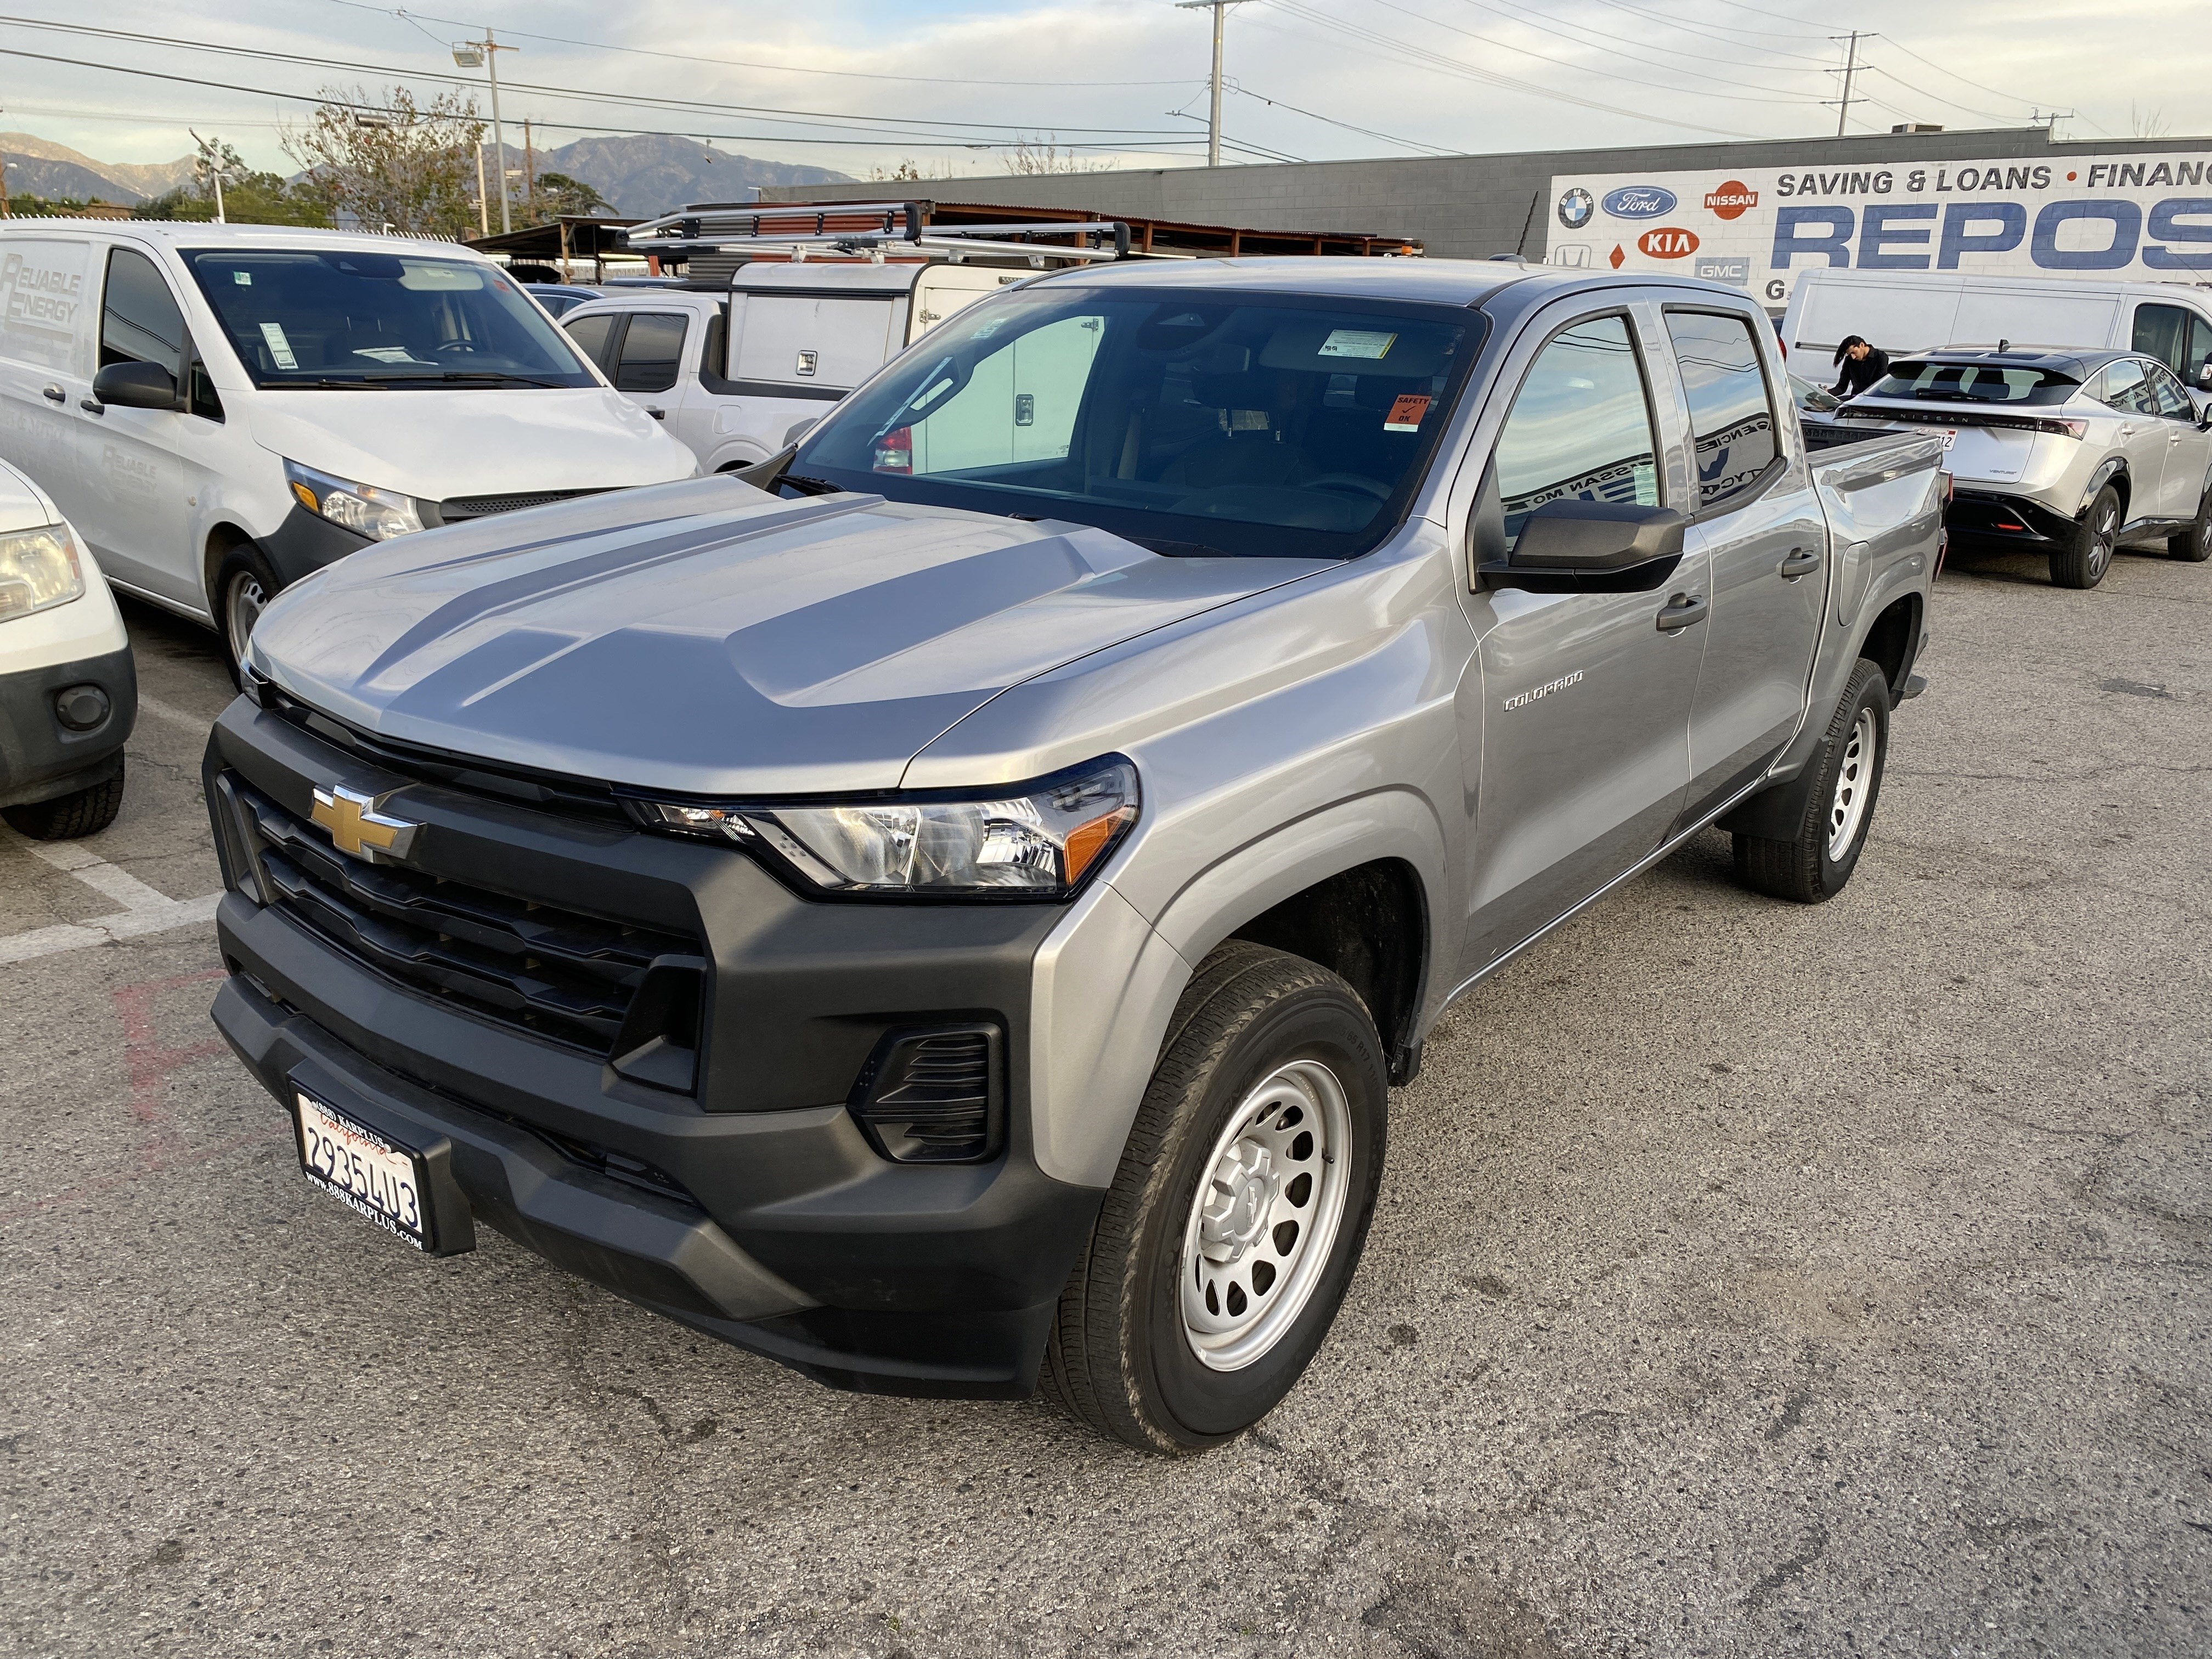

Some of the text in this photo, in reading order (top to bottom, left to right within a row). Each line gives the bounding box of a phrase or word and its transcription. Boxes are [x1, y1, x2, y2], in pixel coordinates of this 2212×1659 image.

[1777, 161, 2212, 196] SAVING & LOANS FINAN
[1561, 189, 1593, 206] BMW
[1617, 194, 1660, 212] Ford
[1706, 194, 1755, 207] NISSAN
[1647, 234, 1691, 253] KIA
[0, 253, 81, 296] RELIABLE
[1700, 264, 1742, 278] GMC
[5, 292, 79, 327] ENERGY
[1397, 397, 1429, 405] SAFETY
[1900, 413, 1968, 424] NISSAN
[1503, 669, 1584, 713] COLORADO
[315, 1100, 385, 1148] (888) KARPLUS
[320, 1112, 397, 1165] California
[306, 1171, 423, 1251] www.888KARPLUS.COM
